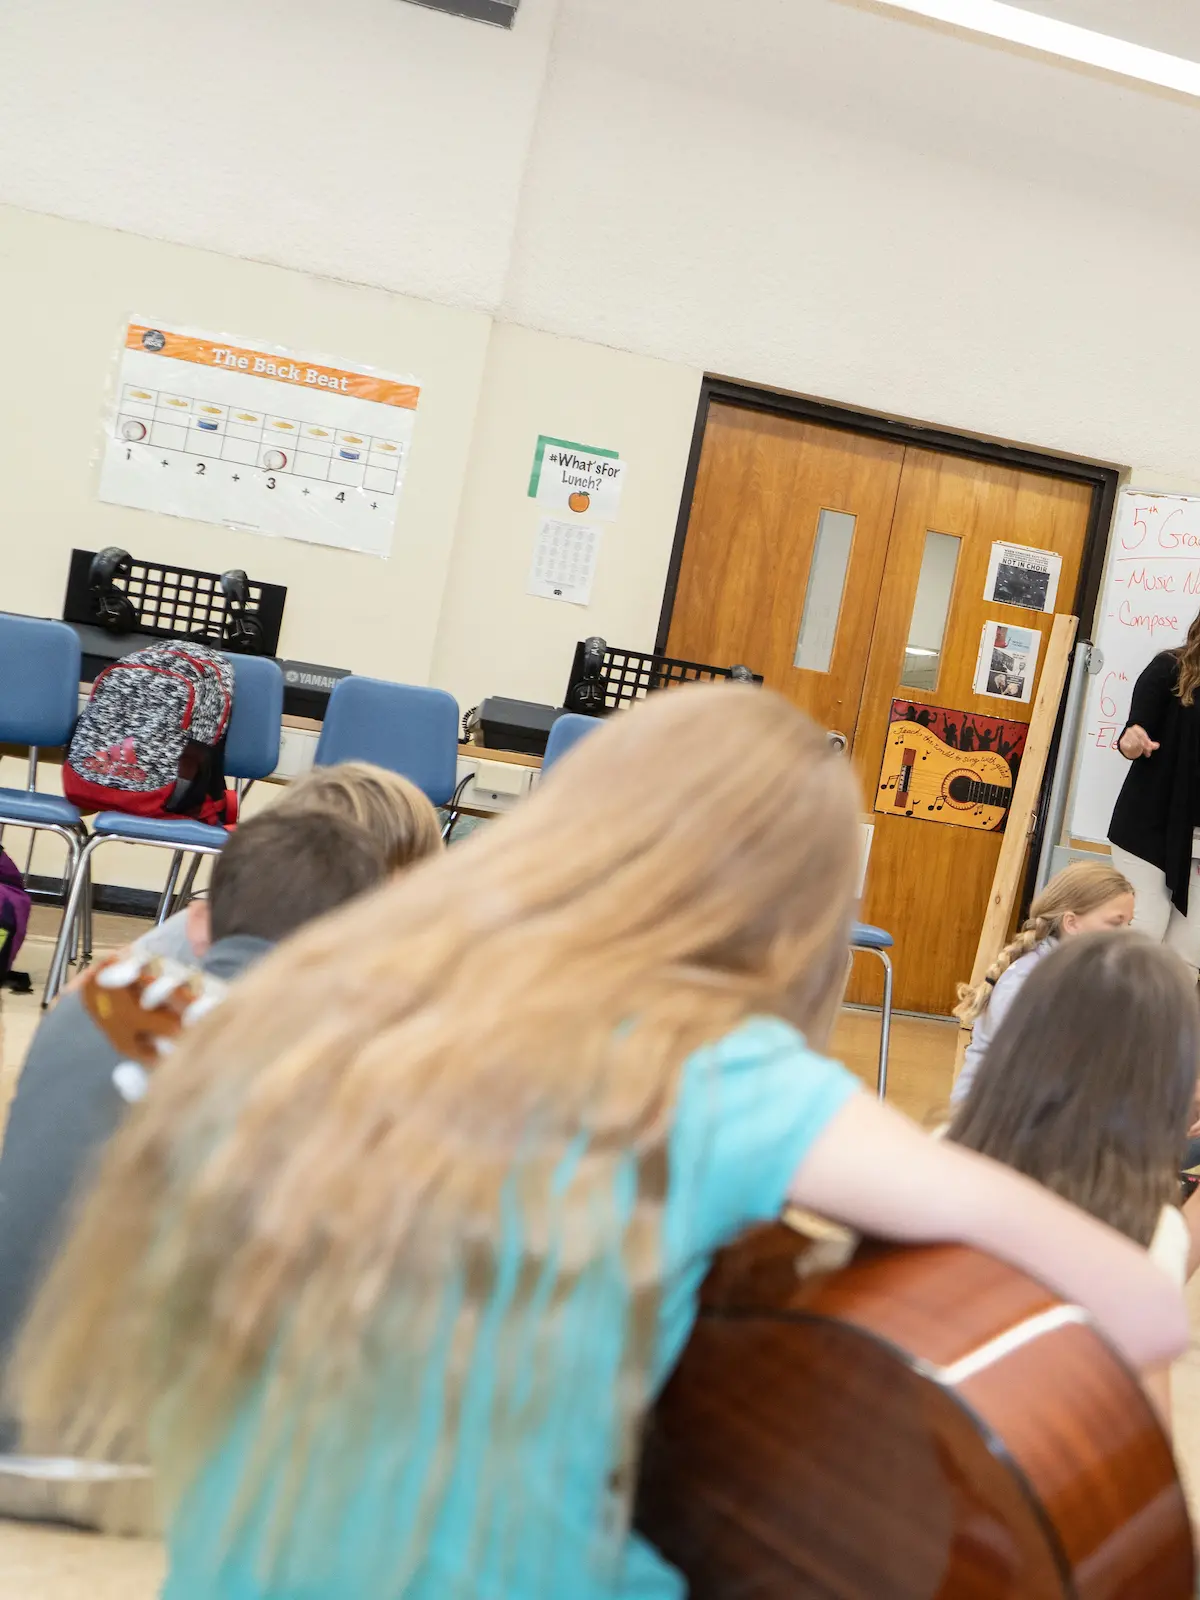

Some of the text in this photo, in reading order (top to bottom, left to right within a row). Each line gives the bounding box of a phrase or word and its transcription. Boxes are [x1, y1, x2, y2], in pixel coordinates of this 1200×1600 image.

[212, 347, 349, 393] The Back Beat
[125, 448, 132, 460] 1
[195, 462, 206, 476] 2
[266, 477, 276, 490] 3
[335, 491, 346, 504] 4
[561, 470, 602, 491] Lunch?
[1026, 564, 1048, 572] CHOIR
[299, 673, 341, 688] YAMAH
